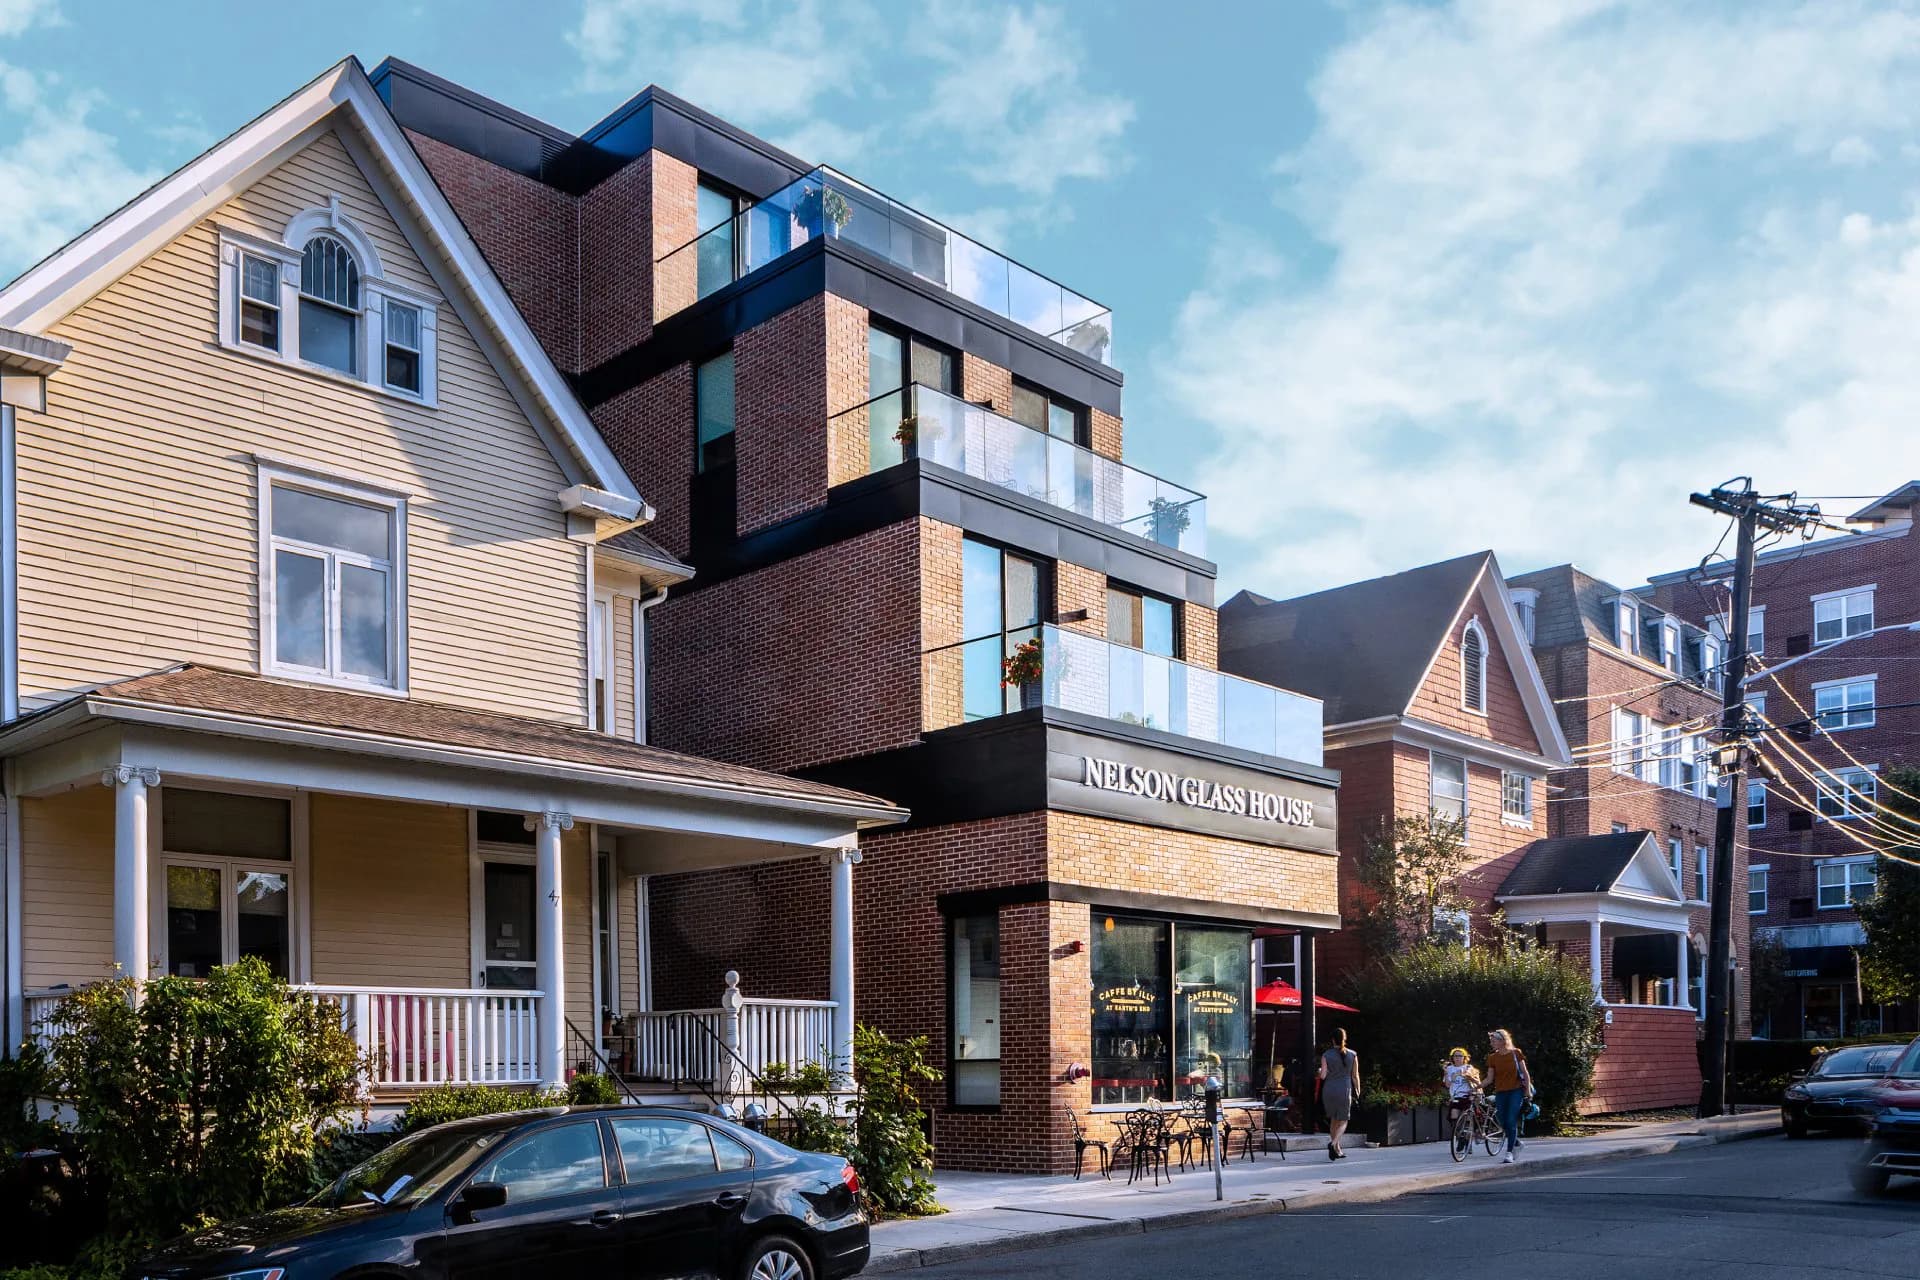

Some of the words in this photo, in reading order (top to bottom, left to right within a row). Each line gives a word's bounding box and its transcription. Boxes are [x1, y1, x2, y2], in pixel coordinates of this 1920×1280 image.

[1082, 756, 1178, 802] NELSON
[1181, 776, 1246, 815] GLASS
[1249, 791, 1314, 827] HOUSE
[548, 888, 560, 907] 47
[1099, 987, 1125, 1001] CAFFE
[1127, 987, 1139, 997] BY
[1138, 990, 1155, 1003] ILLY
[1187, 990, 1211, 1003] CAFFE
[1212, 990, 1222, 998] BY
[1223, 993, 1239, 1005] ILLY
